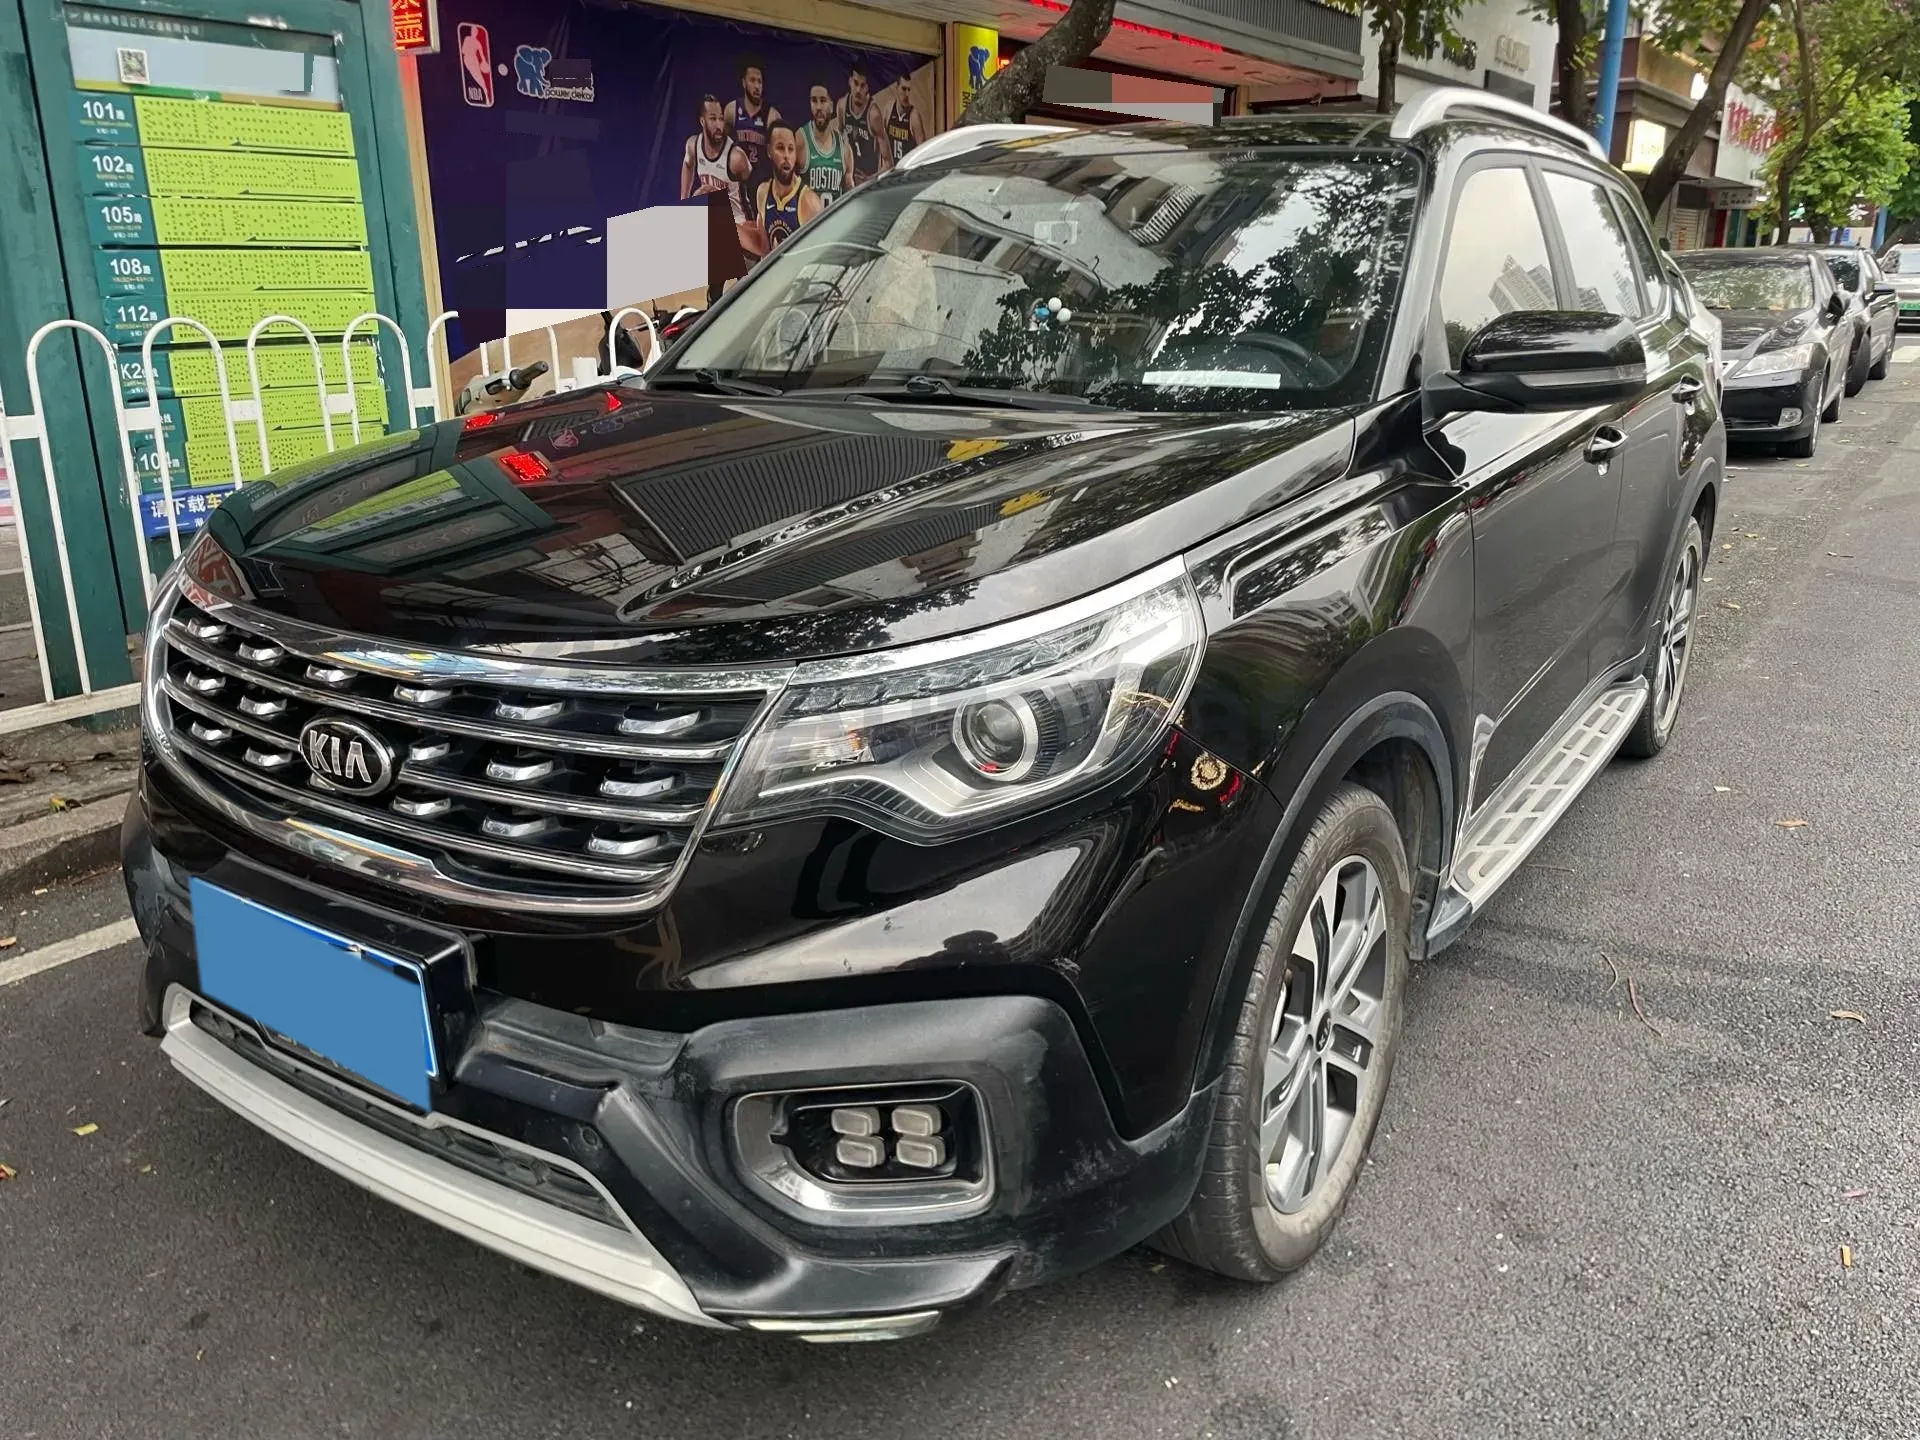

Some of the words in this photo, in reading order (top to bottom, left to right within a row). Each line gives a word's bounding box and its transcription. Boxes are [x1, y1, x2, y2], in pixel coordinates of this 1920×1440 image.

[468, 87, 483, 101] NBA
[546, 88, 570, 99] power
[571, 89, 593, 100] dekor
[893, 139, 903, 159] 15
[809, 168, 843, 191] BOSTON
[151, 491, 233, 518] 请下载车
[309, 729, 372, 784] KIA
